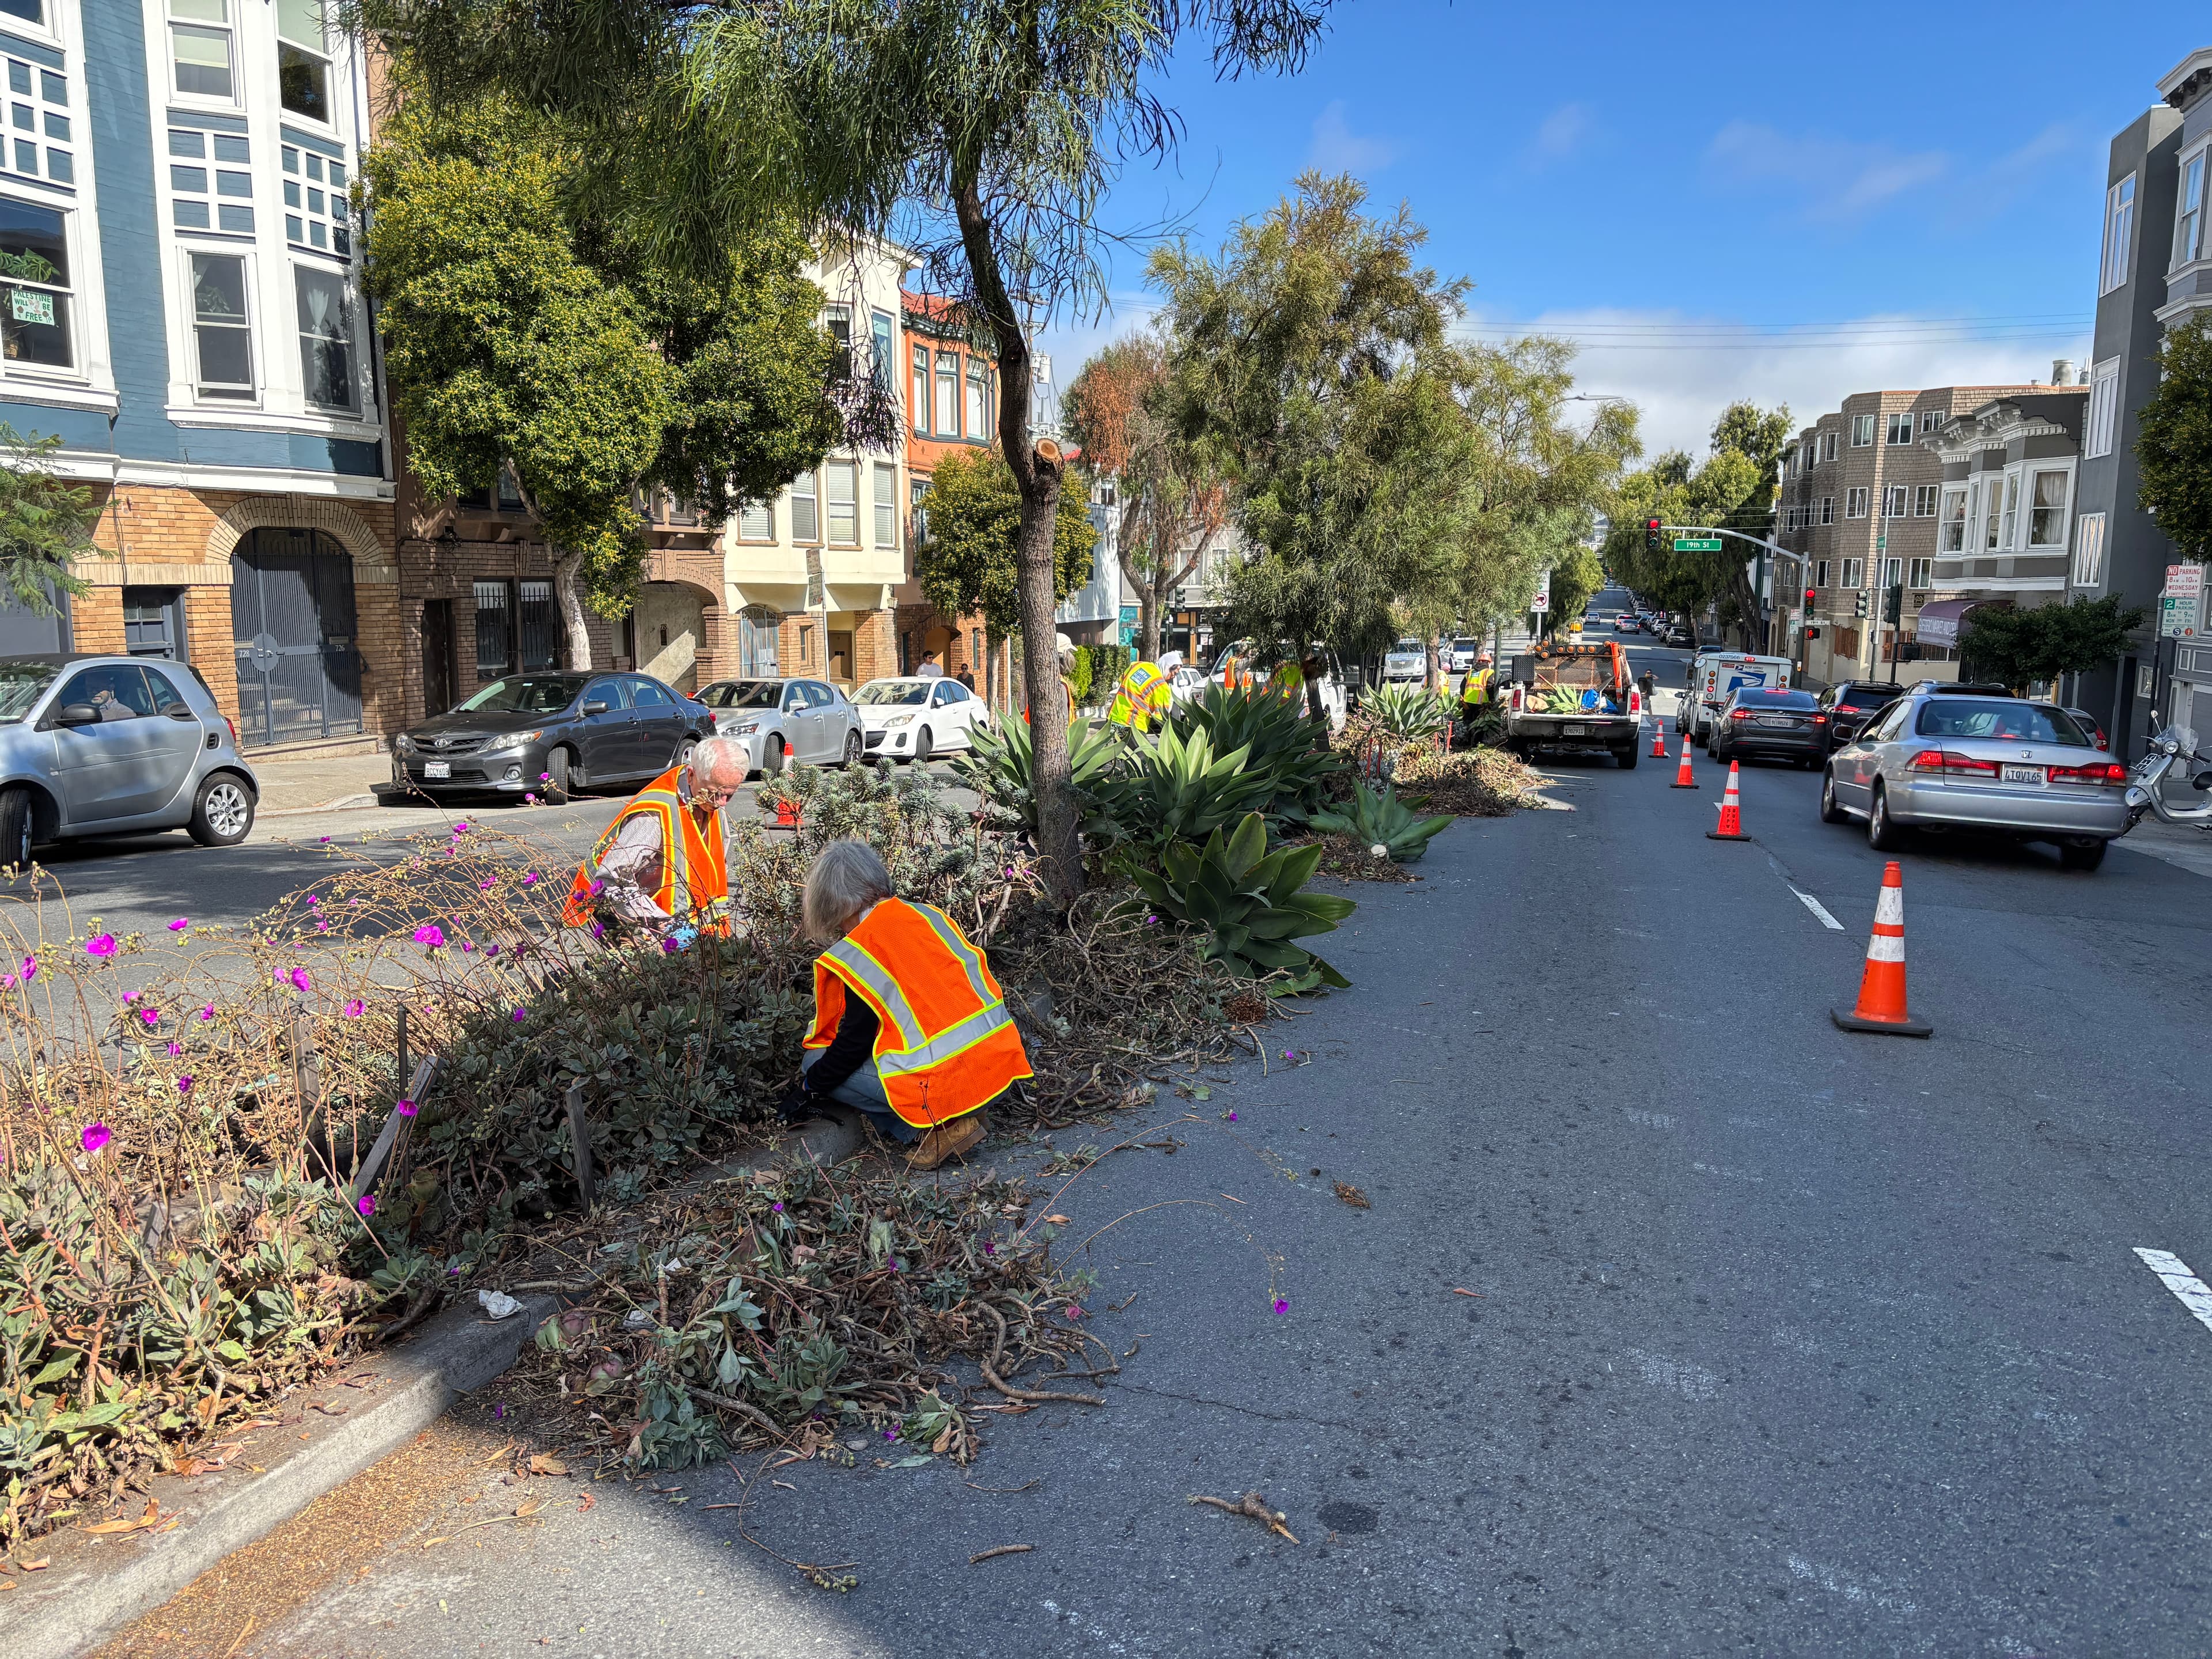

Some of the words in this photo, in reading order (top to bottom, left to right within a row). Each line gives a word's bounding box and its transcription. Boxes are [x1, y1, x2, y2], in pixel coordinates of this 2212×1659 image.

[14, 290, 51, 302] PALESTINE
[26, 312, 42, 321] FREE
[2168, 566, 2177, 575] NO
[2166, 600, 2173, 608] 2
[240, 649, 250, 657] 728
